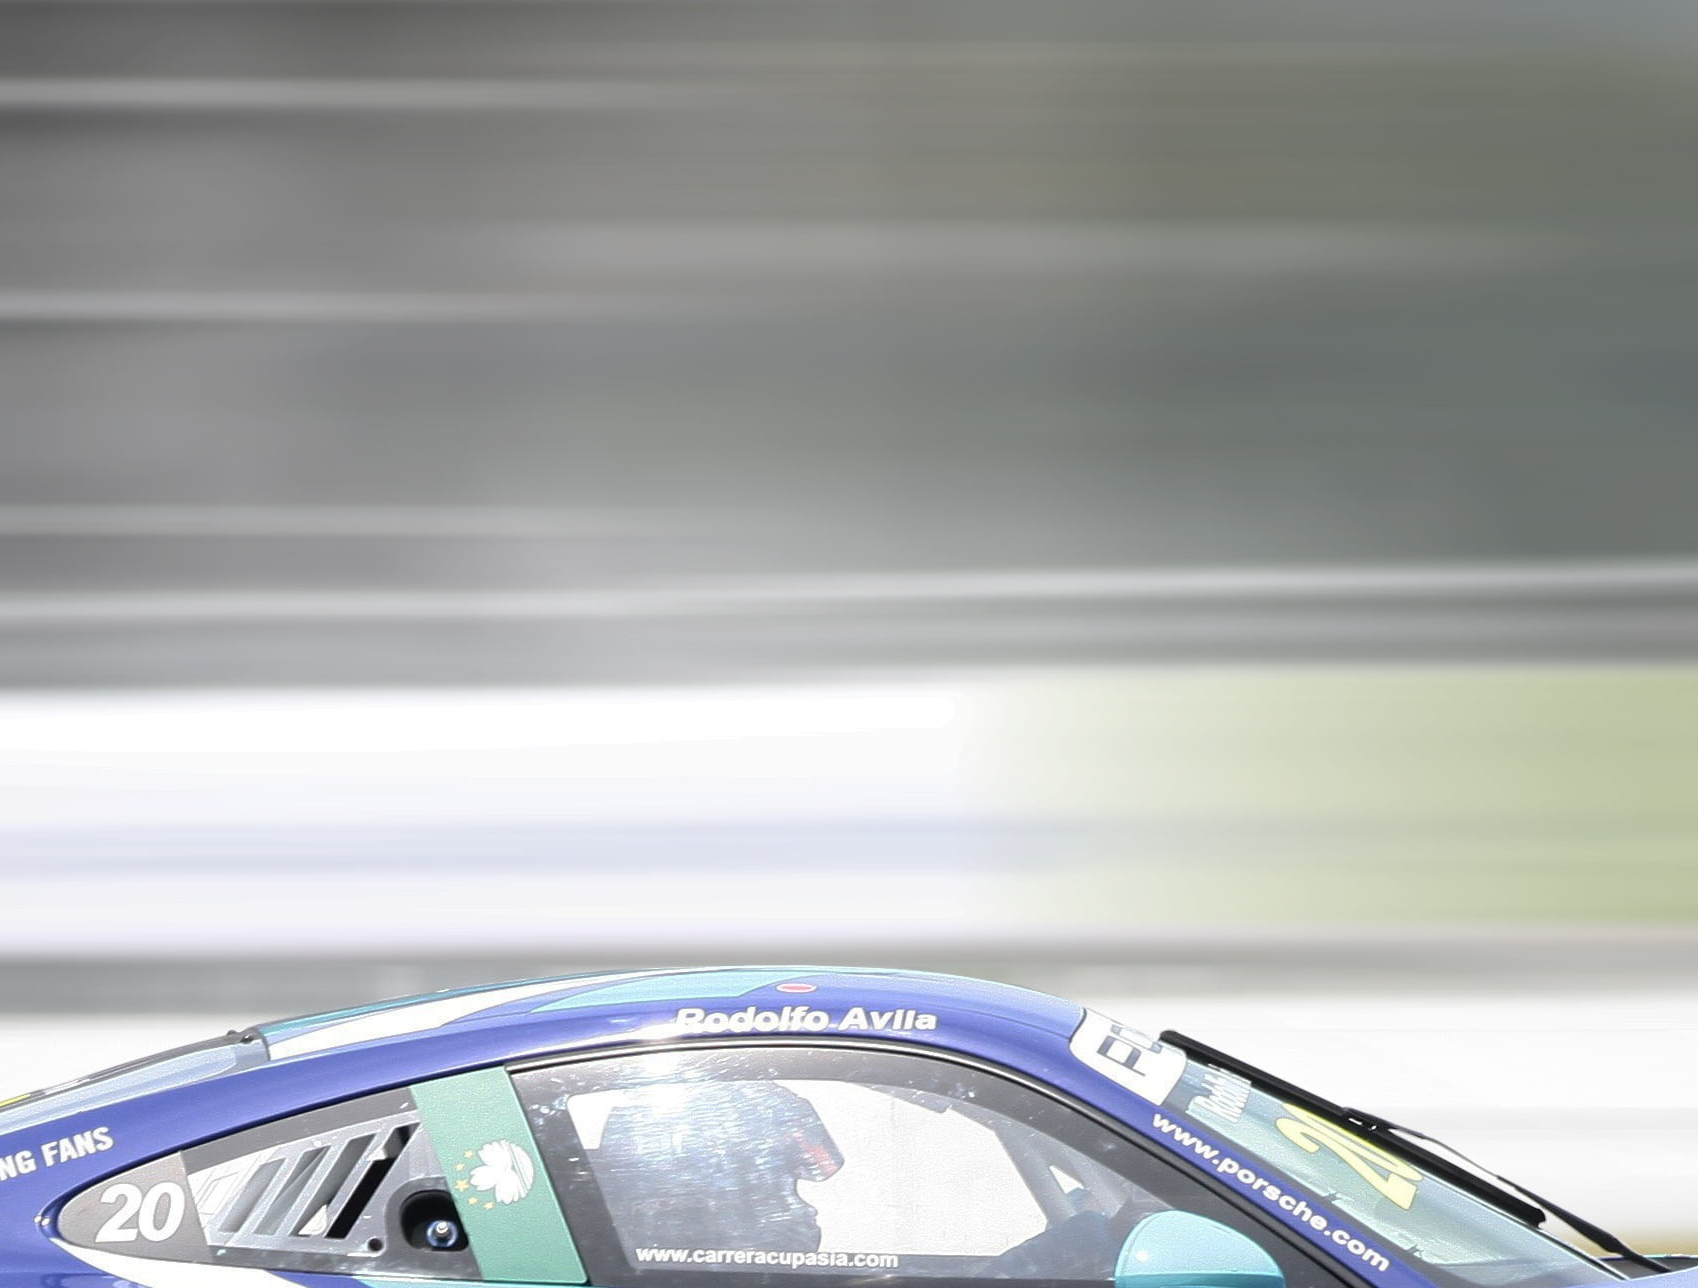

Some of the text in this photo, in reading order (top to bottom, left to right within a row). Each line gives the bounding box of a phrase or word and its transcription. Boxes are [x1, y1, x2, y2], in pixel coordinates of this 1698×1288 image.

[675, 1006, 938, 1033] Rodolfo Avila
[41, 1126, 114, 1167] FANS
[95, 1181, 184, 1243] 20
[1153, 1113, 1391, 1272] www.porsche.com
[635, 1245, 899, 1269] www.carreracupasia.com
